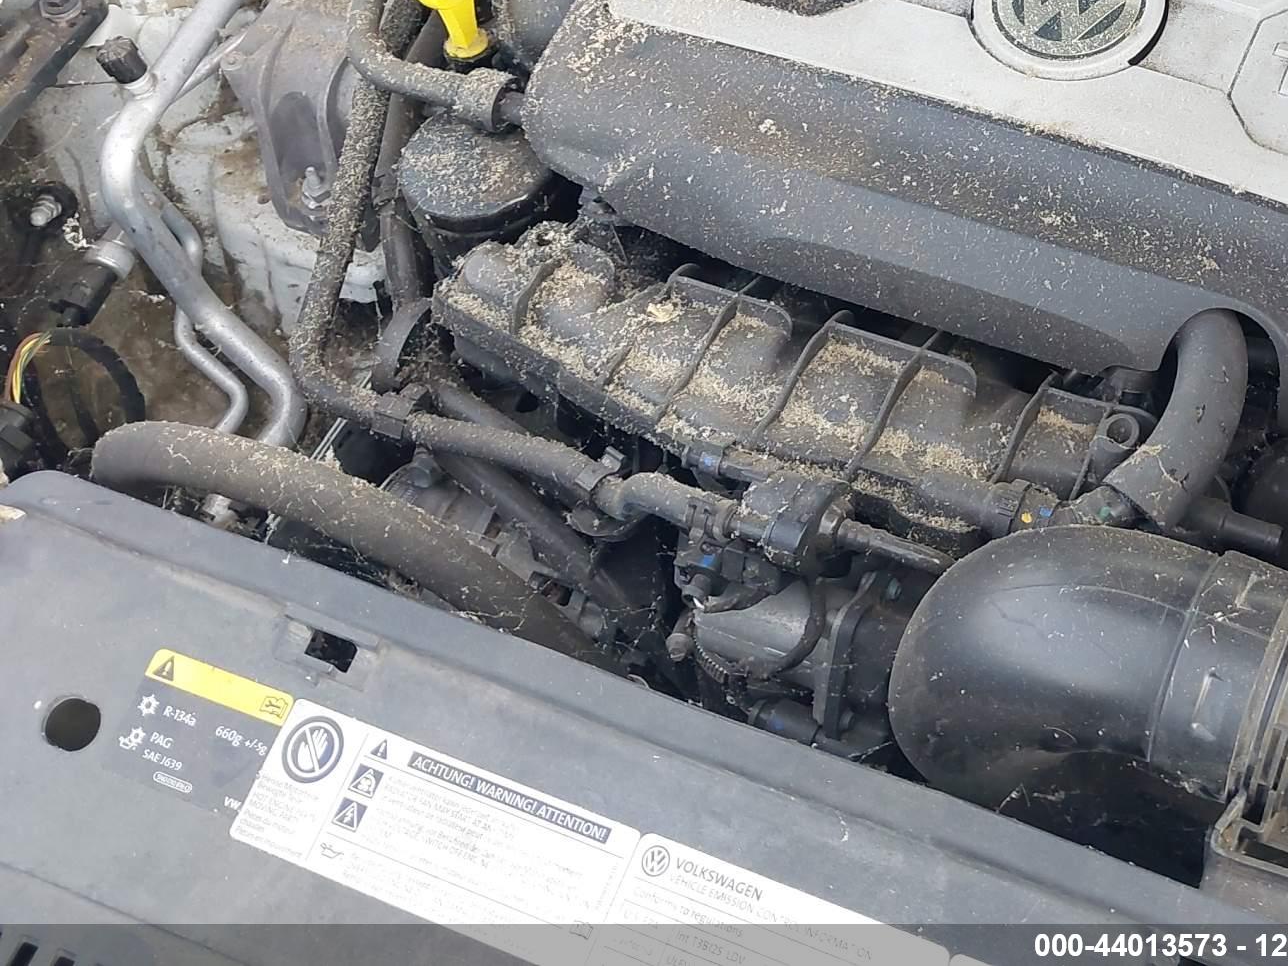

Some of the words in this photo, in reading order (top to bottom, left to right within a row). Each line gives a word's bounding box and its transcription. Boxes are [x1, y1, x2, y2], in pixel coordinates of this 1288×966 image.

[150, 731, 174, 749] PAG
[163, 705, 197, 726] R-134a
[215, 725, 244, 747] 660g
[142, 749, 161, 763] SAE
[160, 752, 183, 770] J639
[412, 756, 475, 788] ACHTUNG!
[476, 780, 538, 814] WARNING!
[536, 804, 608, 842] ATTENTION!
[670, 874, 706, 896] VEHICLE
[708, 888, 754, 914] EMISSION
[675, 857, 763, 901] VOLKSWAGEN
